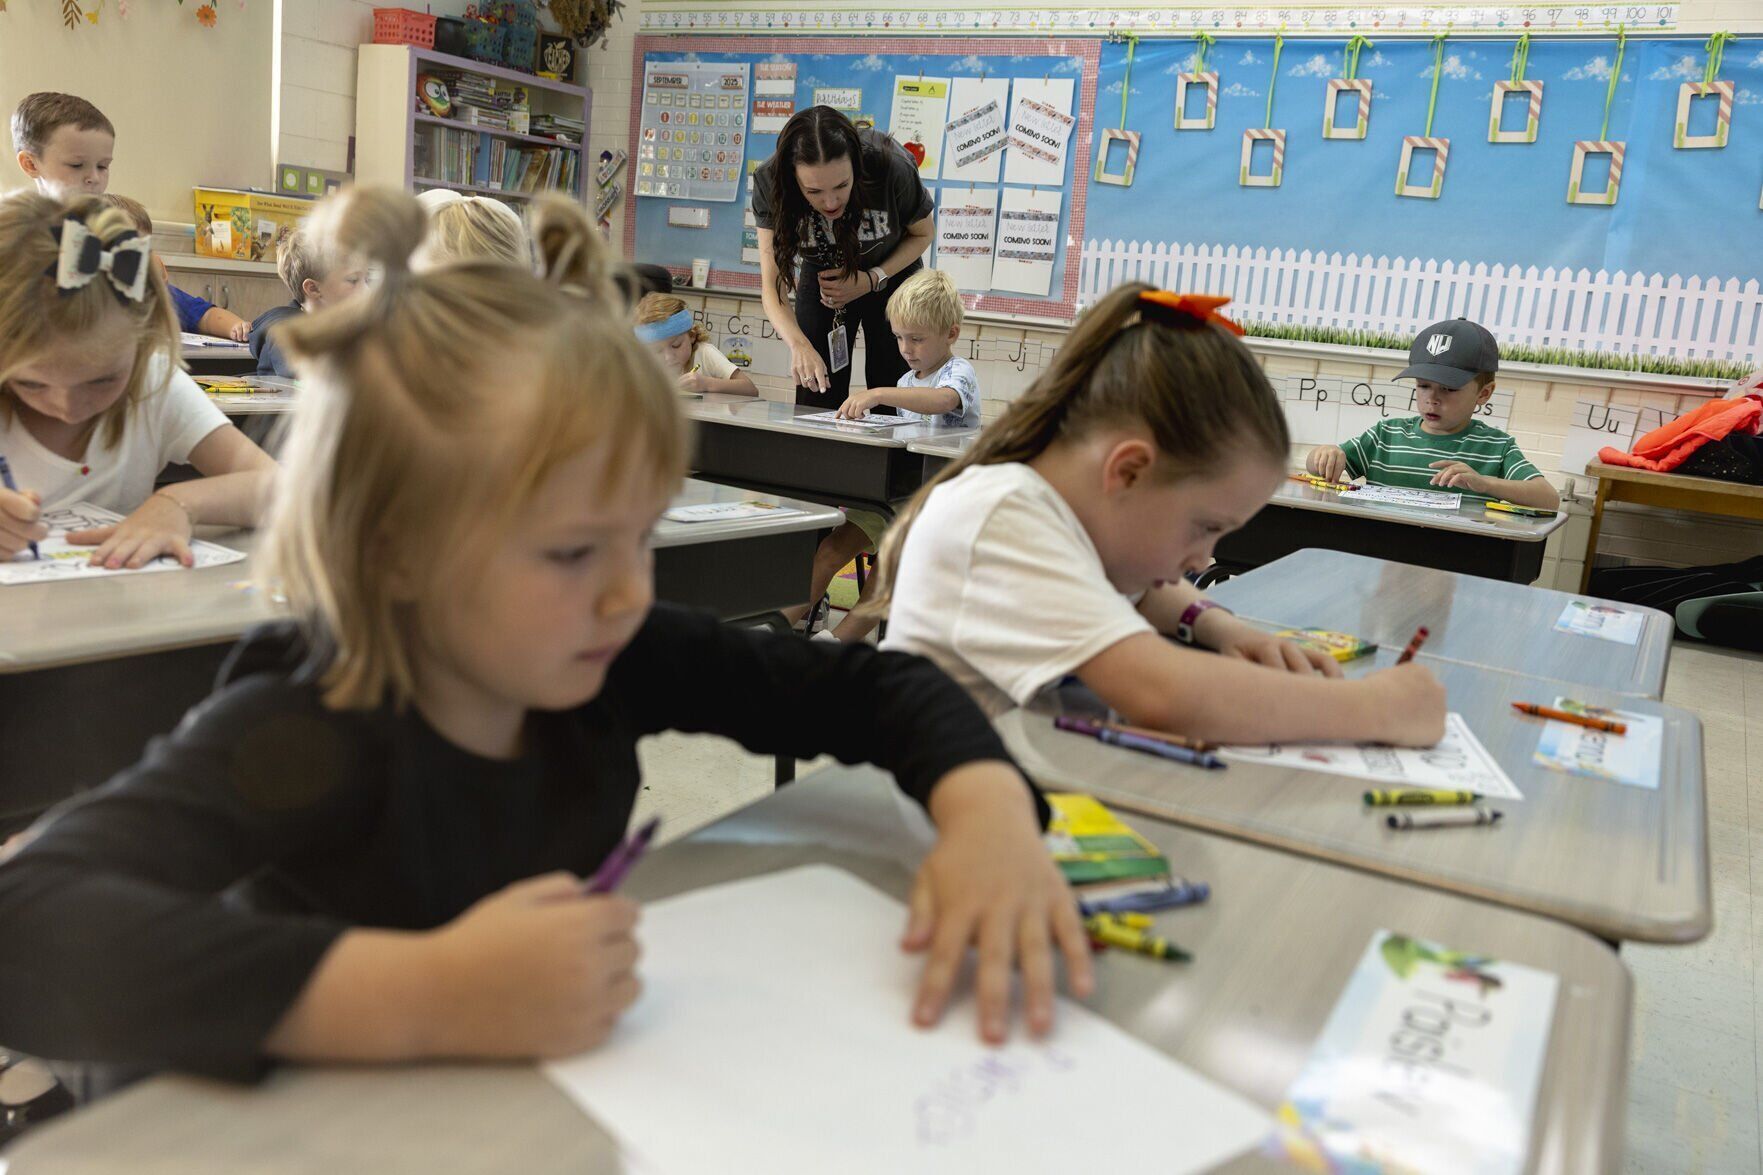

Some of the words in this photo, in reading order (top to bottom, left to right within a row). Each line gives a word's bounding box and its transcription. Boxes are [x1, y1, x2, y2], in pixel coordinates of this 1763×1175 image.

[1496, 9, 1509, 20] 95
[1522, 9, 1536, 20] 96
[1547, 9, 1563, 20] 97
[1575, 9, 1589, 20] 98
[1602, 8, 1617, 18] 99
[1626, 8, 1647, 18] 100
[1657, 8, 1672, 18] 101
[956, 136, 982, 152] COMING
[982, 126, 1001, 141] SOON!
[1015, 124, 1040, 140] COMING
[1041, 136, 1061, 149] SOON!
[942, 232, 969, 240] COMING
[970, 232, 990, 240] SOON!
[1004, 236, 1030, 245] COMING
[1032, 238, 1052, 246] SOON!
[728, 316, 750, 335] Cc
[1300, 378, 1328, 412] Pp
[1352, 382, 1390, 418] Qq
[1588, 404, 1620, 434] Uu
